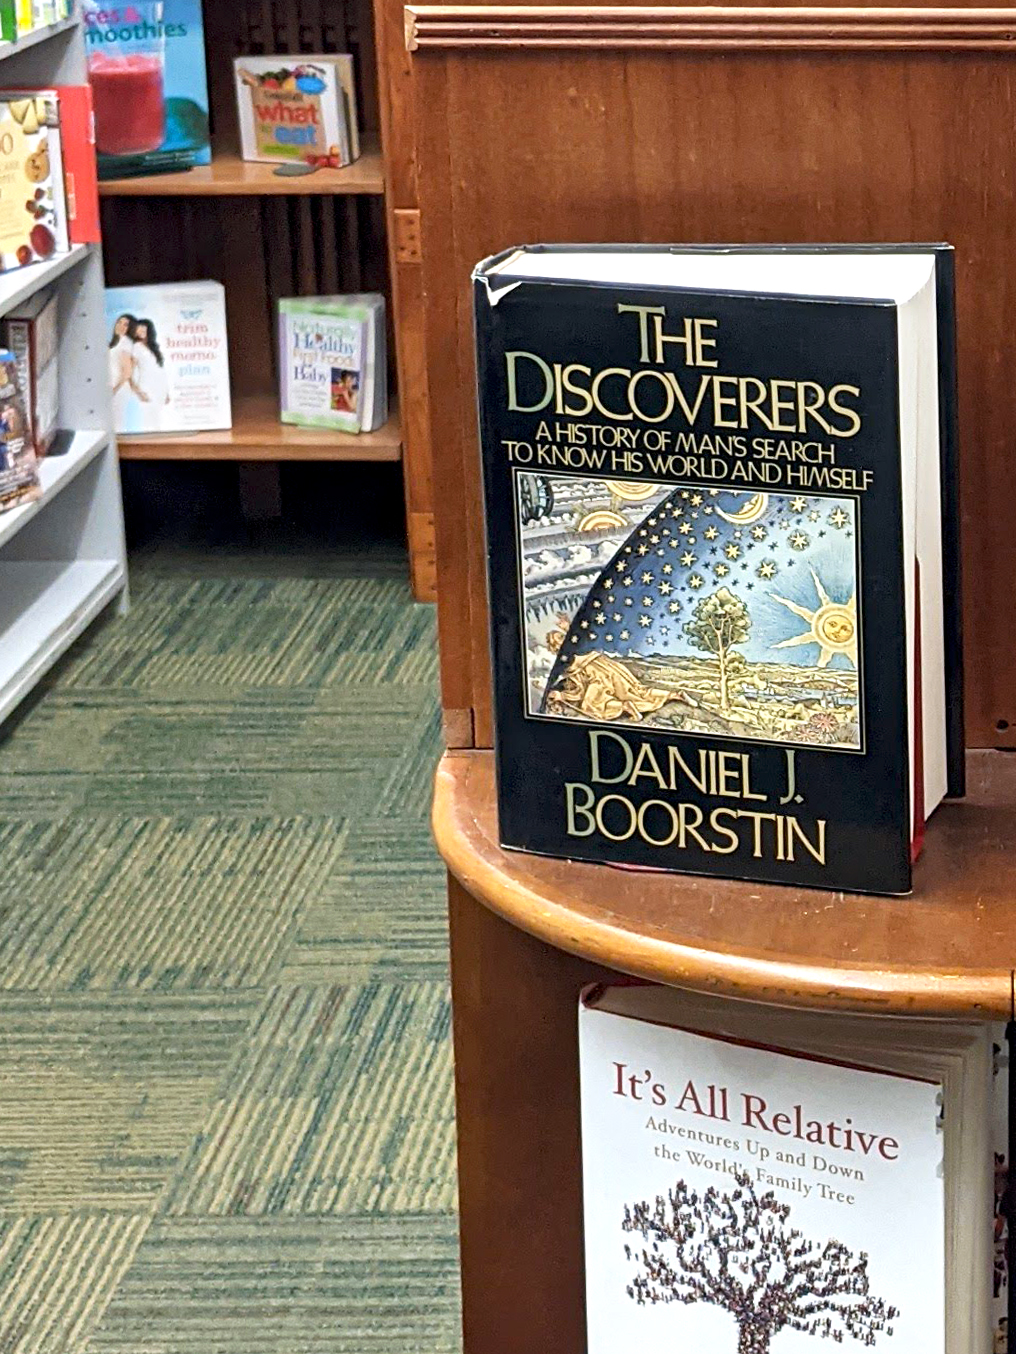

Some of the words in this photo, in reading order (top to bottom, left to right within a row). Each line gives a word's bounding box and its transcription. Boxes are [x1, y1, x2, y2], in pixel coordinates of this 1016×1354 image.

[255, 101, 319, 125] what
[166, 335, 221, 349] healthy
[293, 331, 356, 356] Healthy
[618, 302, 719, 368] THE
[293, 365, 327, 383] Baby
[504, 350, 862, 438] DISCOVERERS
[502, 441, 531, 462] TO
[536, 442, 603, 470] KNOW
[611, 450, 644, 473] HIS
[647, 452, 729, 481] WORLD
[730, 460, 783, 485] AND
[786, 464, 874, 491] HIMSELF
[536, 423, 552, 442] A
[553, 424, 641, 451] HISTORY
[643, 430, 671, 451] OF
[676, 432, 748, 459] MAN'S
[752, 438, 835, 464] SEARCH
[589, 730, 767, 802] DANIEL
[780, 749, 805, 805] J.
[566, 782, 826, 864] BOORSTIN
[612, 1060, 666, 1106] It's
[674, 1080, 731, 1122] All
[740, 1092, 900, 1160] Relative
[645, 1116, 740, 1152] Adventures
[746, 1139, 770, 1161] Up
[776, 1148, 807, 1168] and
[812, 1155, 866, 1182] Down
[654, 1144, 681, 1163] the
[755, 1168, 814, 1199] Family
[816, 1182, 856, 1205] Tree
